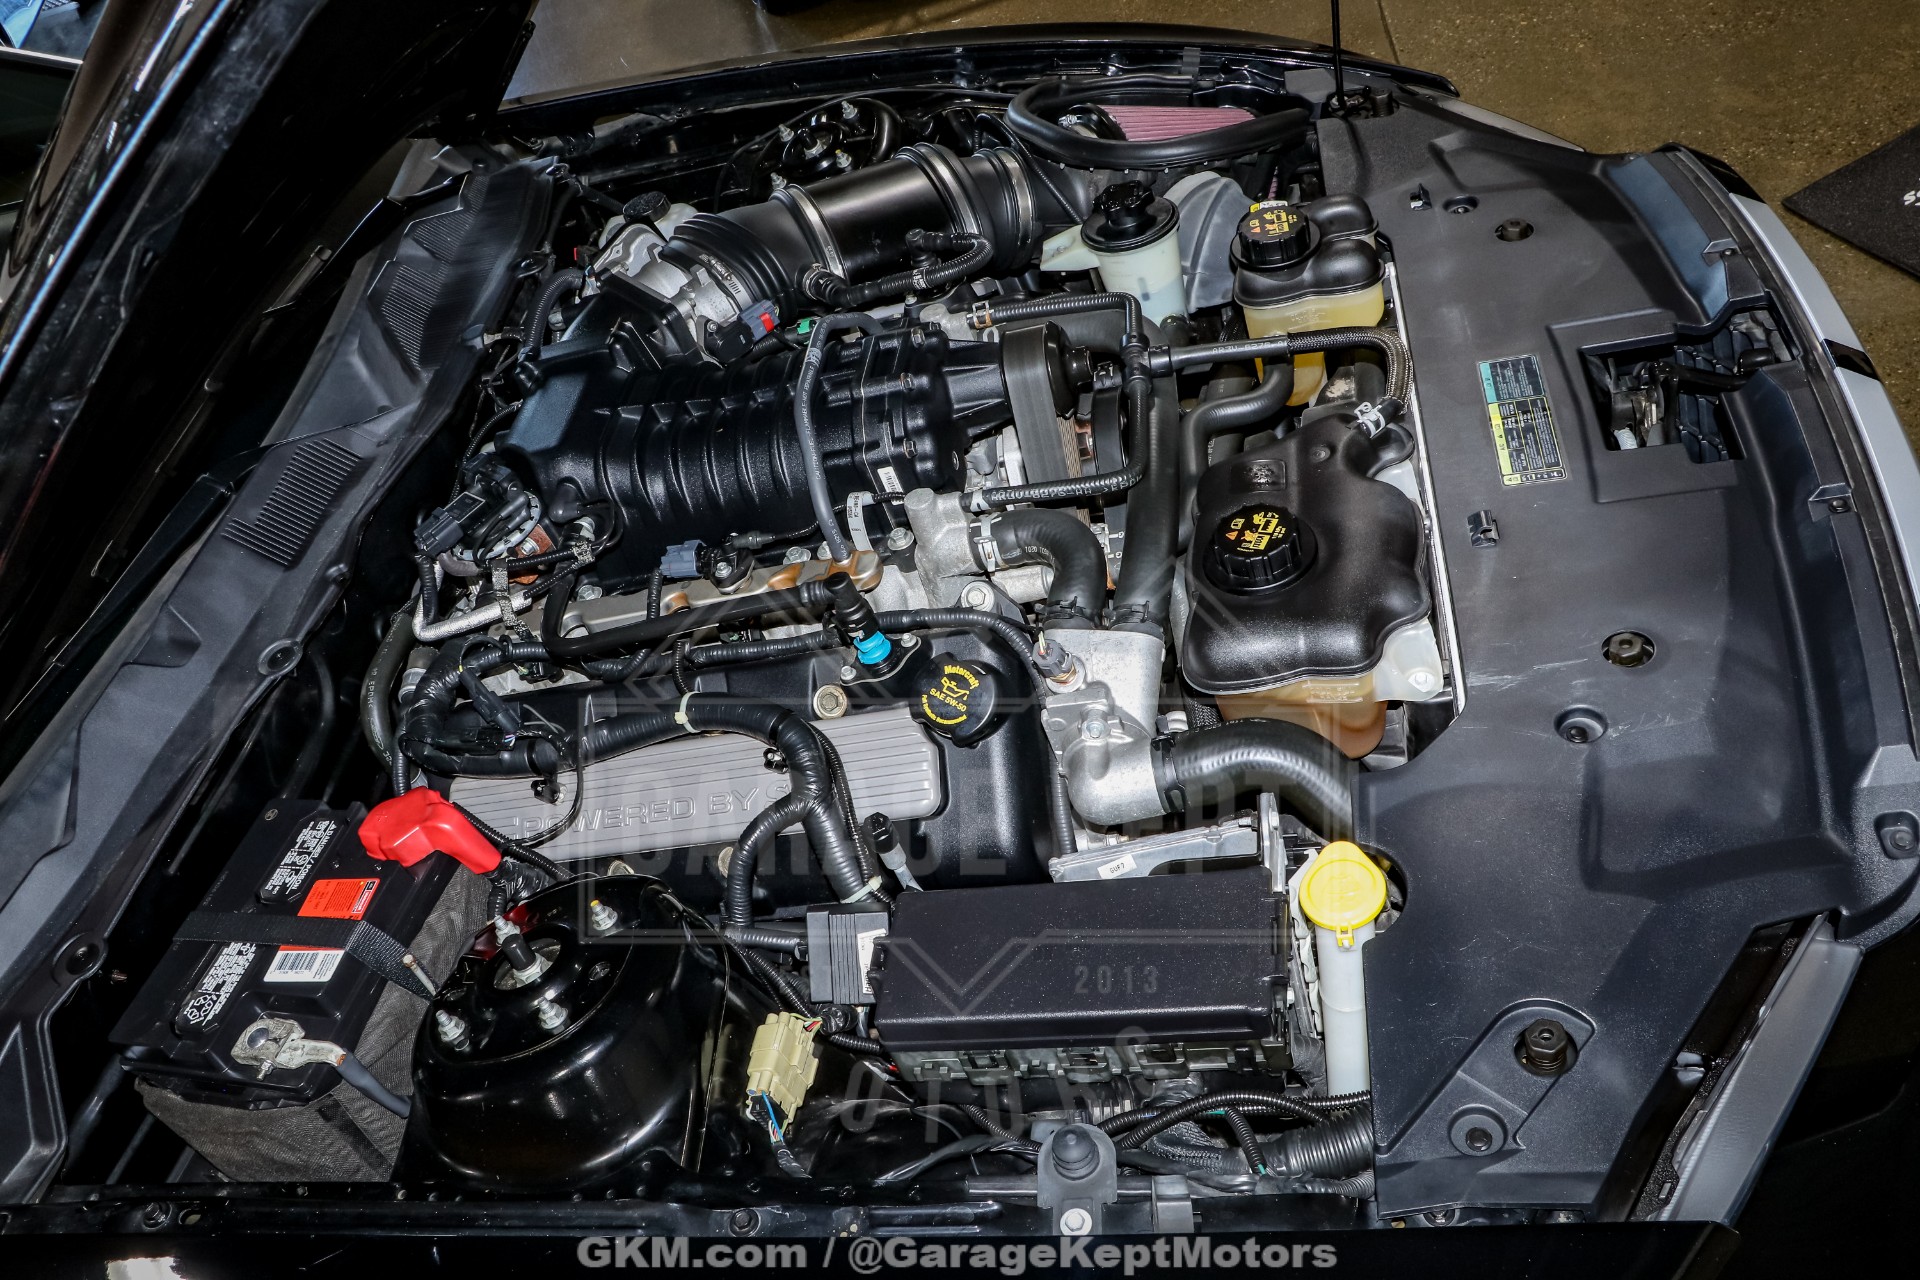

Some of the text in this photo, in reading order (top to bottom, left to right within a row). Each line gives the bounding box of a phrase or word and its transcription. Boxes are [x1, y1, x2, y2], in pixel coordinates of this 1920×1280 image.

[944, 664, 980, 690] Motorcraft
[929, 687, 946, 701] SAE
[944, 696, 967, 712] 5W-50
[706, 786, 760, 817] BY
